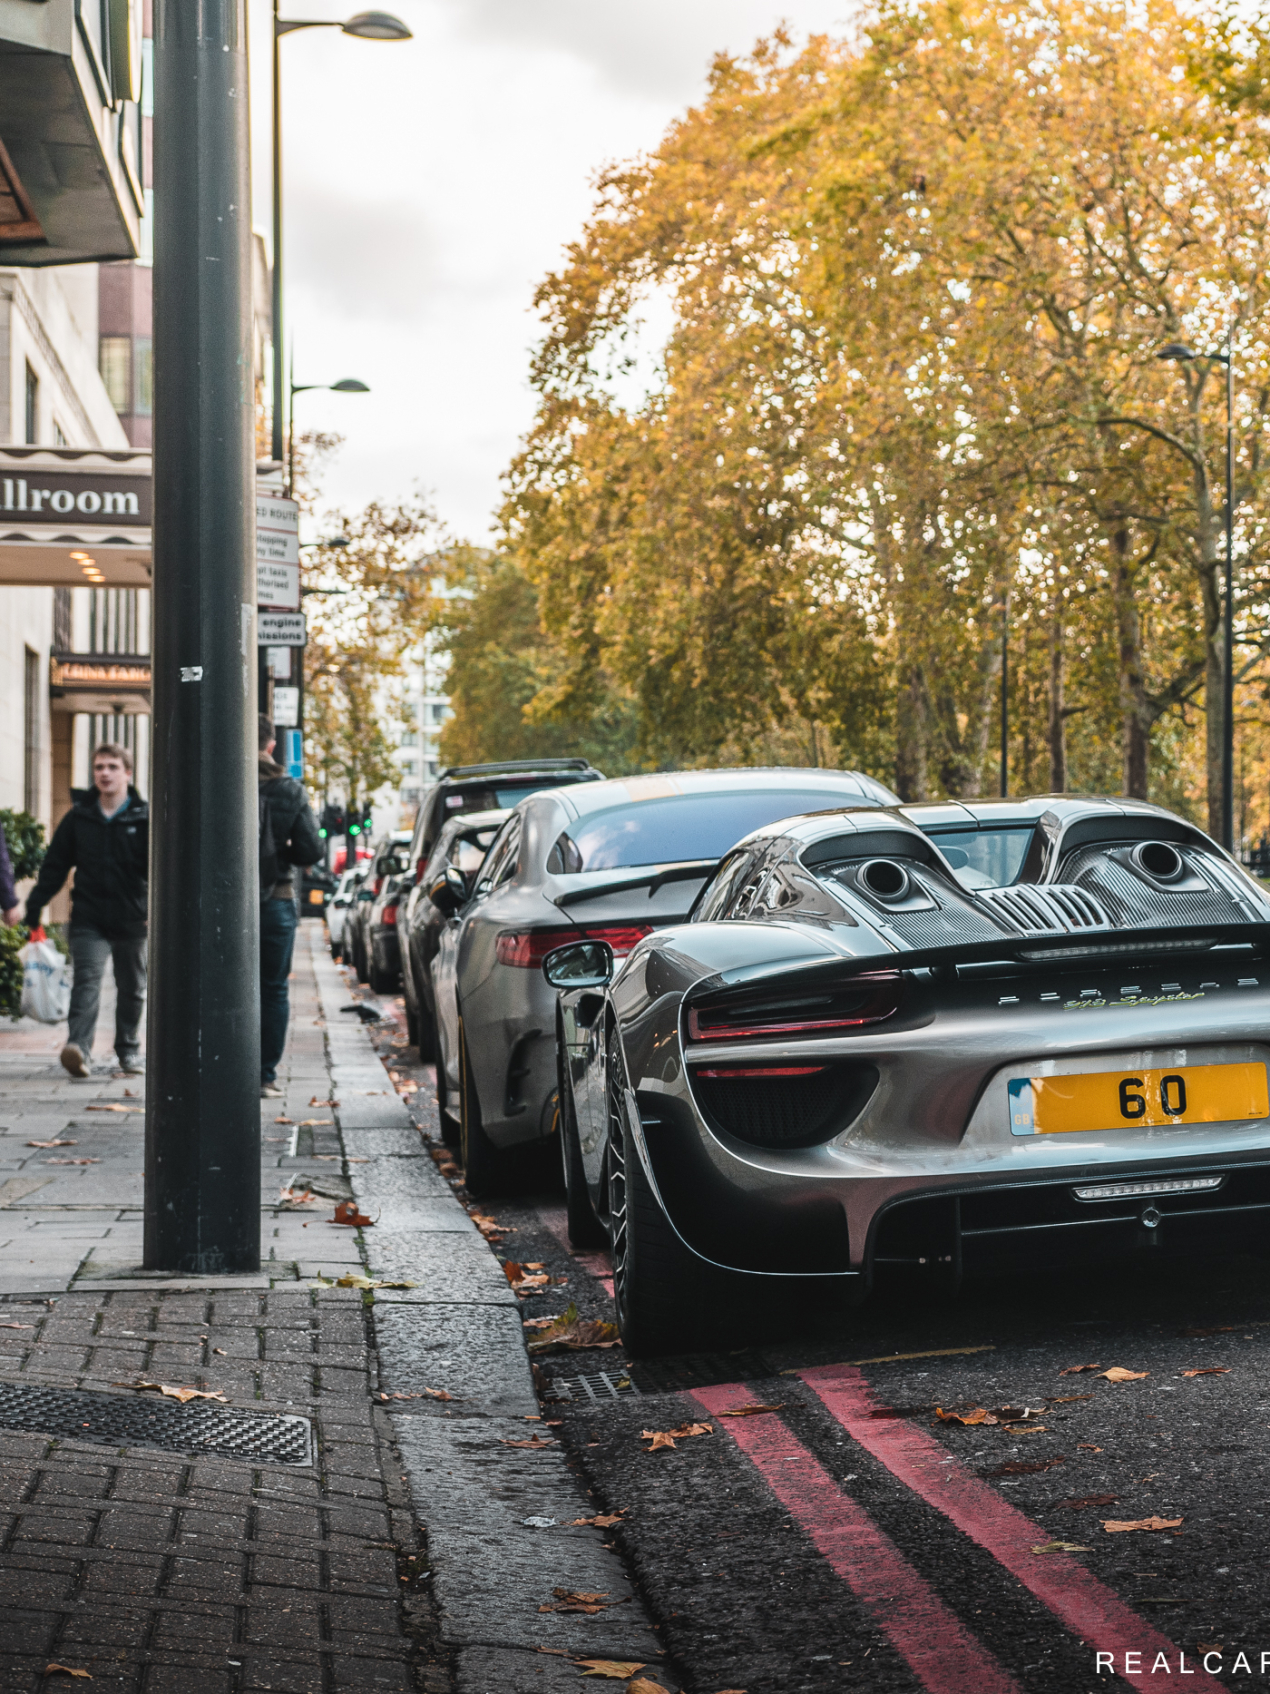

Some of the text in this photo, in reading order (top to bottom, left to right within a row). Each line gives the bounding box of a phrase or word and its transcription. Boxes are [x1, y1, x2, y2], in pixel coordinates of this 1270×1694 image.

[270, 507, 298, 522] ROUTE
[262, 617, 301, 628] engine
[1014, 1113, 1030, 1125] GB
